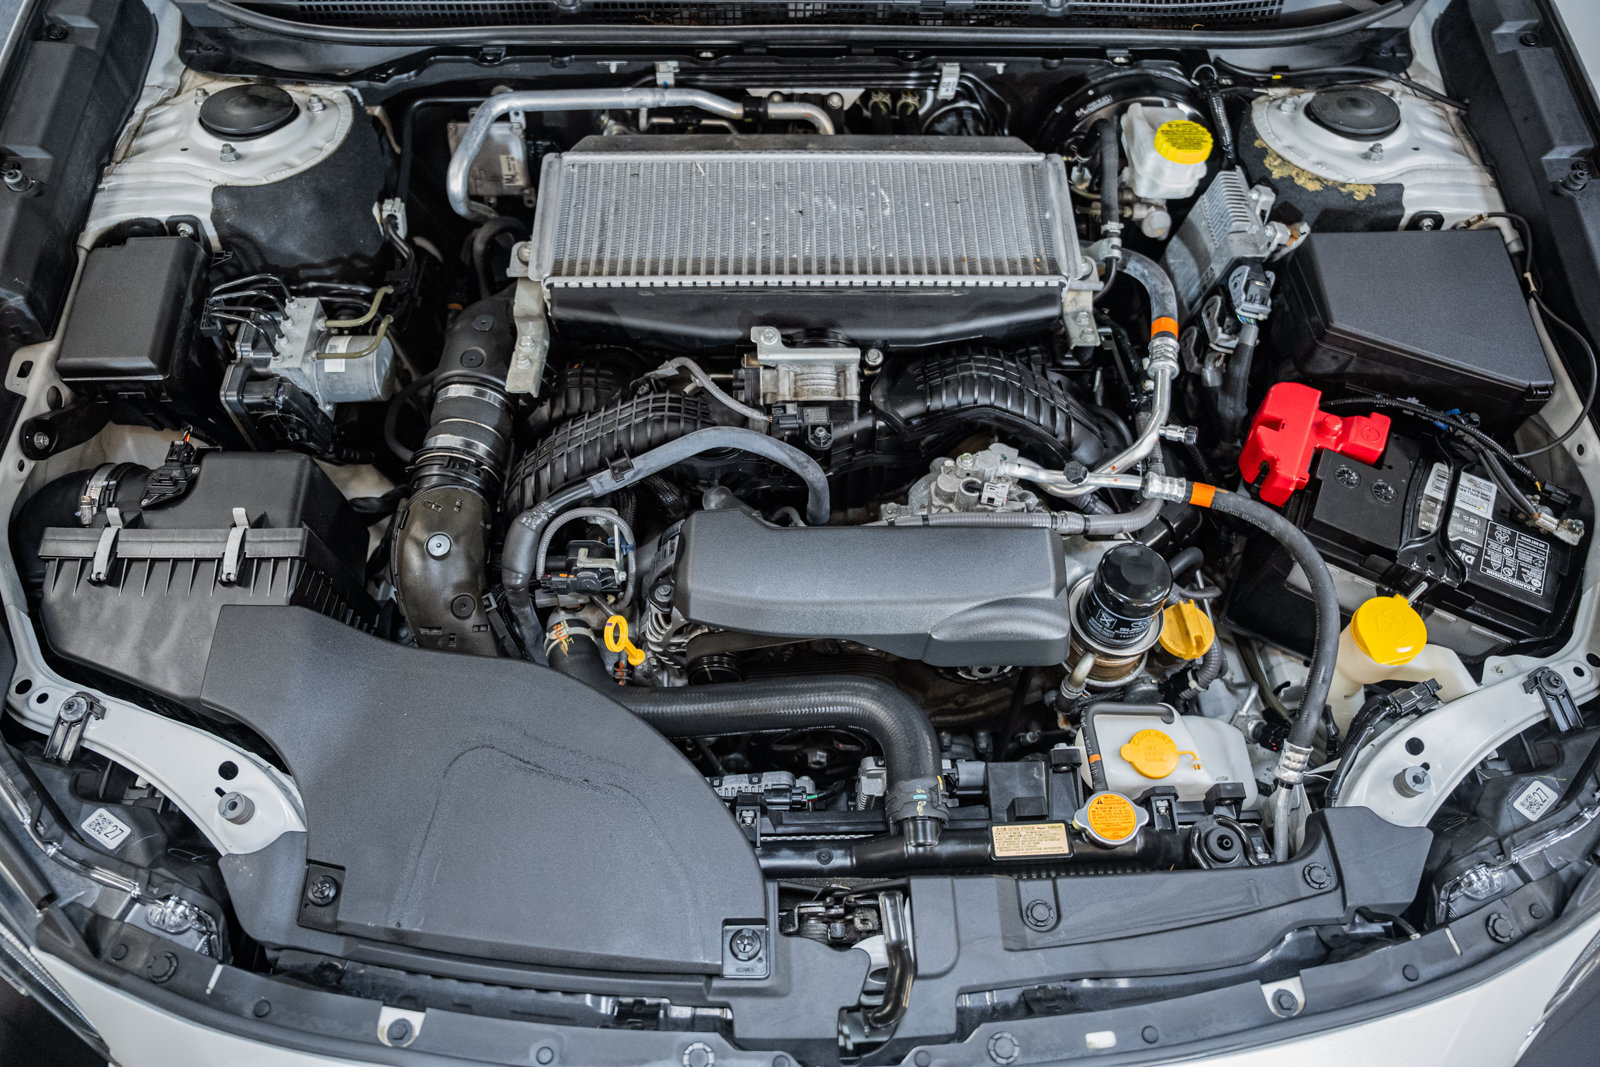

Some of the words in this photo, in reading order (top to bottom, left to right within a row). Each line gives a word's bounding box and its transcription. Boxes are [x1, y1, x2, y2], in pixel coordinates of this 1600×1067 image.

[1133, 731, 1172, 744] COOLANT
[1533, 788, 1549, 803] 27
[104, 825, 124, 840] 27
